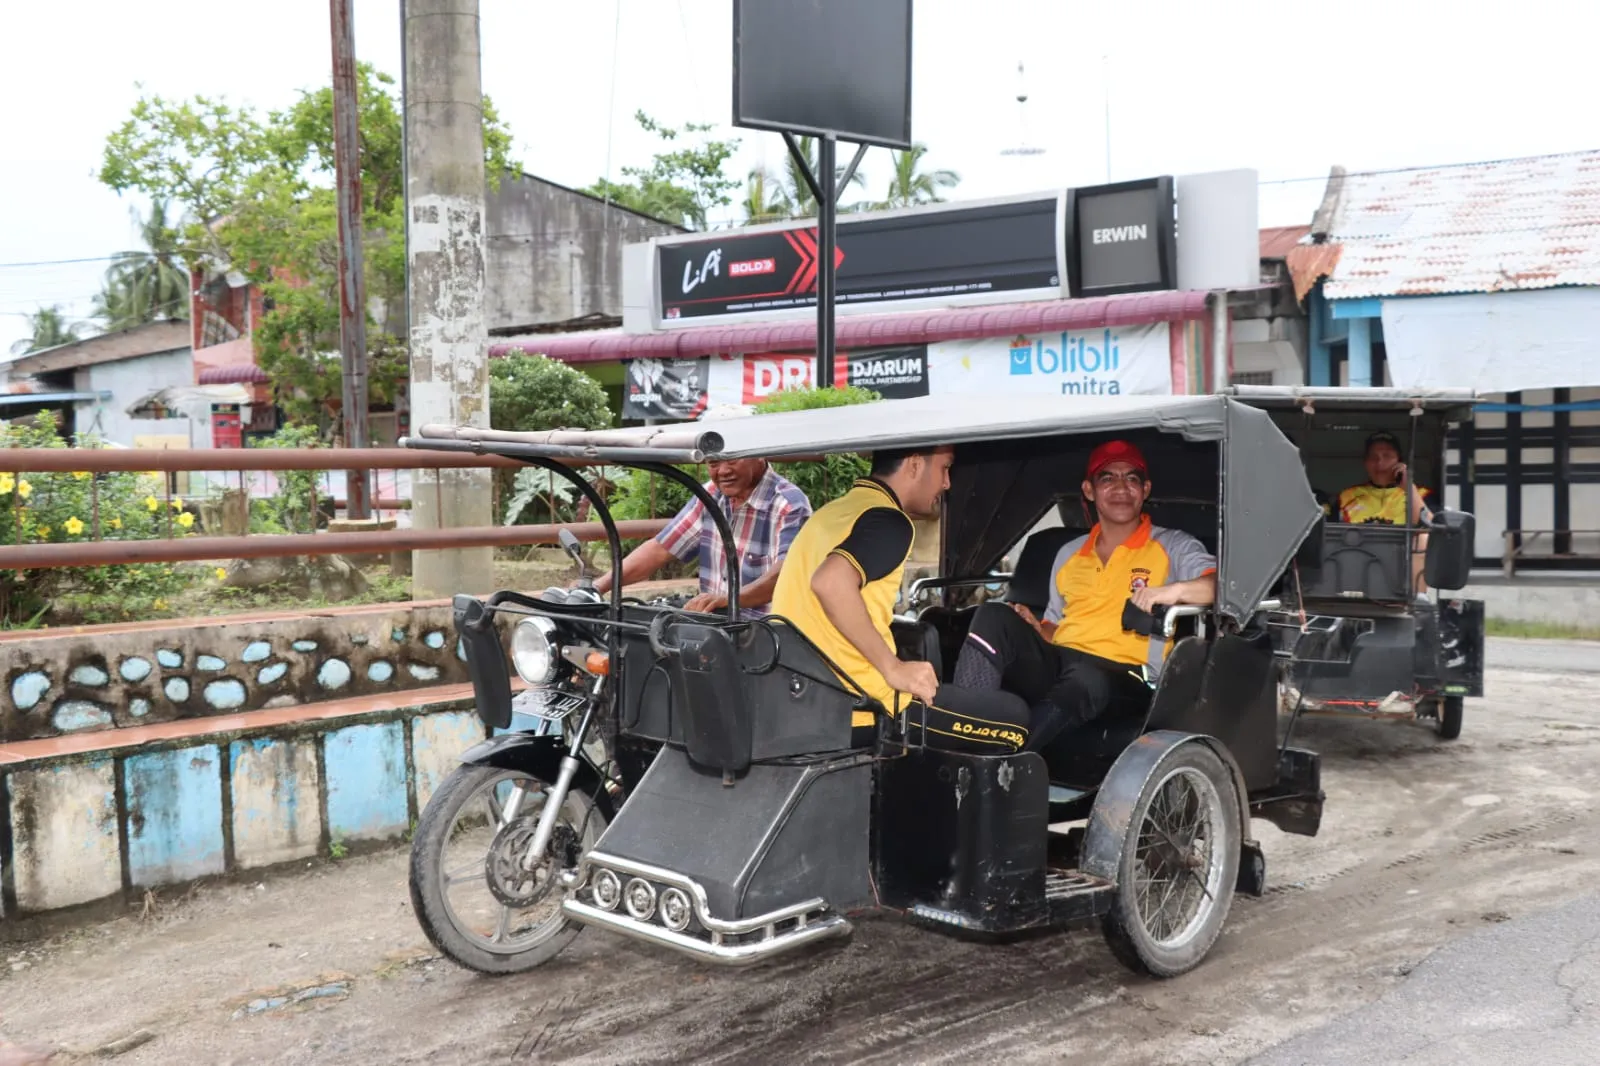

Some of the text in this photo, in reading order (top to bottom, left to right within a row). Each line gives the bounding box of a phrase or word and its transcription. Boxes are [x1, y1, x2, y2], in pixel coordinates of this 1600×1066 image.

[1092, 224, 1147, 245] ERWIN
[731, 261, 763, 273] BOLD
[1036, 328, 1119, 373] blibli
[852, 358, 922, 378] DJARUM
[853, 375, 922, 386] RETAIL PARTNERSHIP
[1061, 375, 1120, 395] mitra
